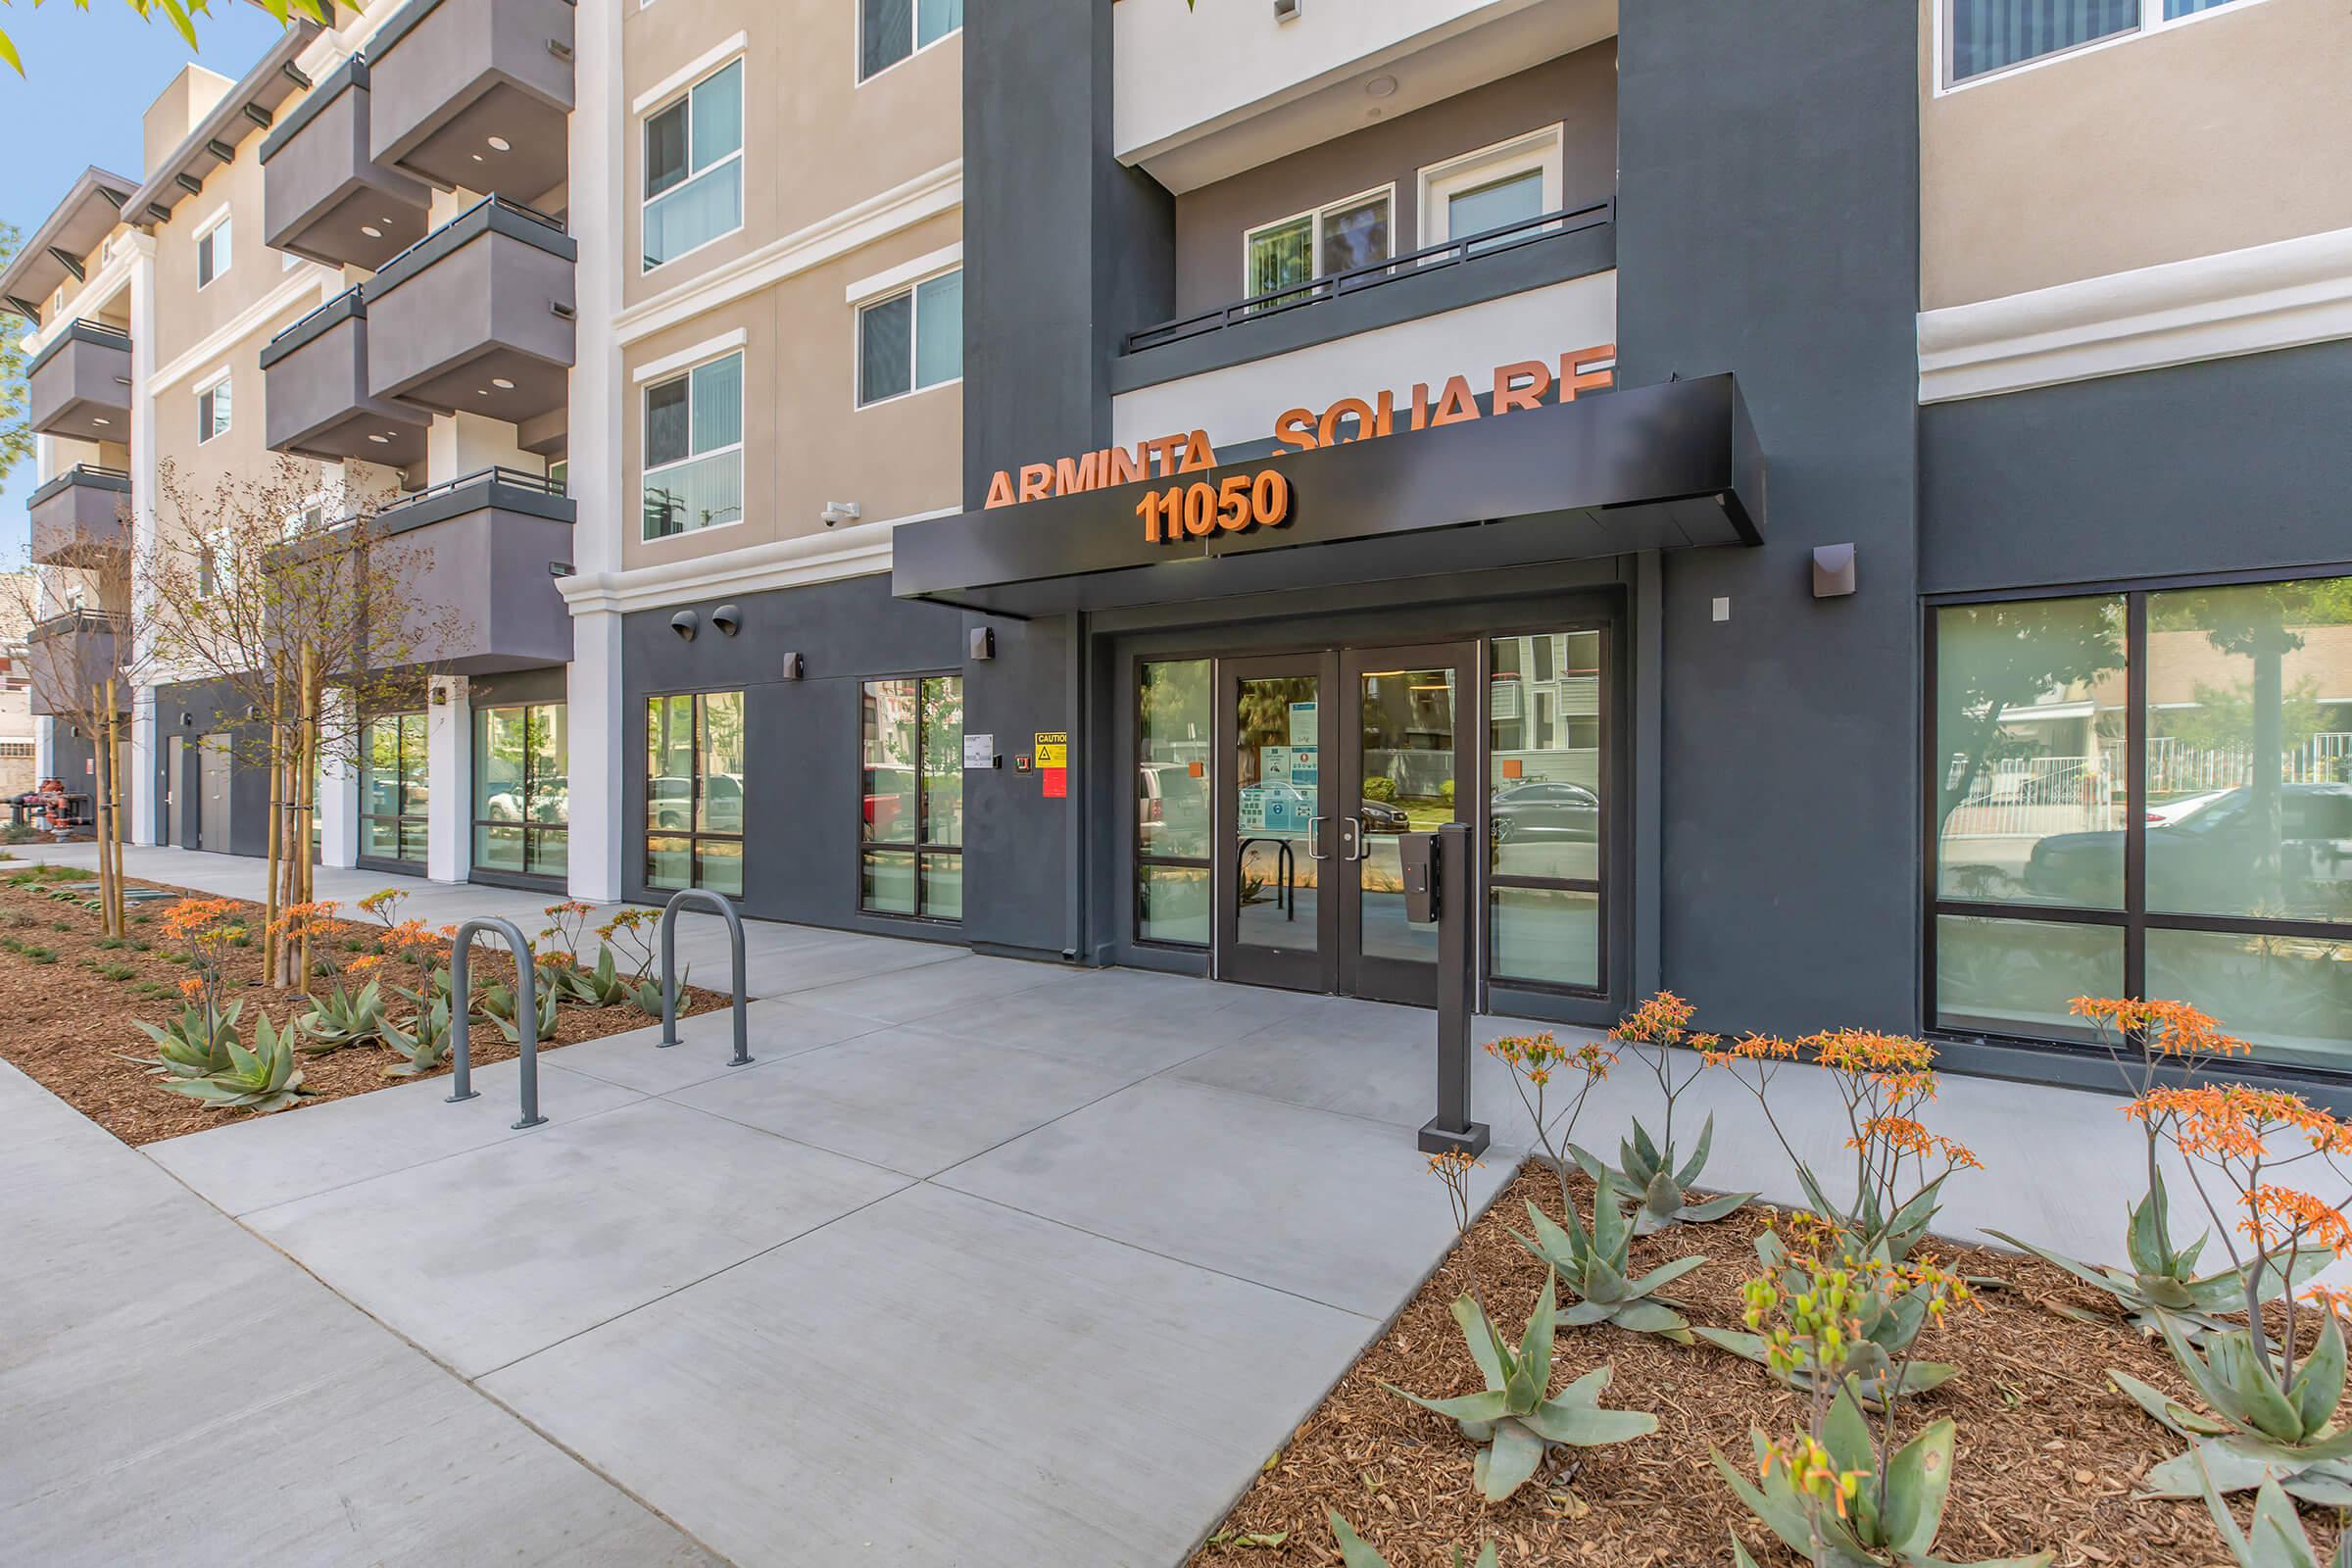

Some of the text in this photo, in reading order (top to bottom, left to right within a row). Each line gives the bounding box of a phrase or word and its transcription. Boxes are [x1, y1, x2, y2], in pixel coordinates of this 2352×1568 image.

[984, 344, 1616, 511] ARMINTA SQUARE
[1136, 469, 1288, 542] 11050
